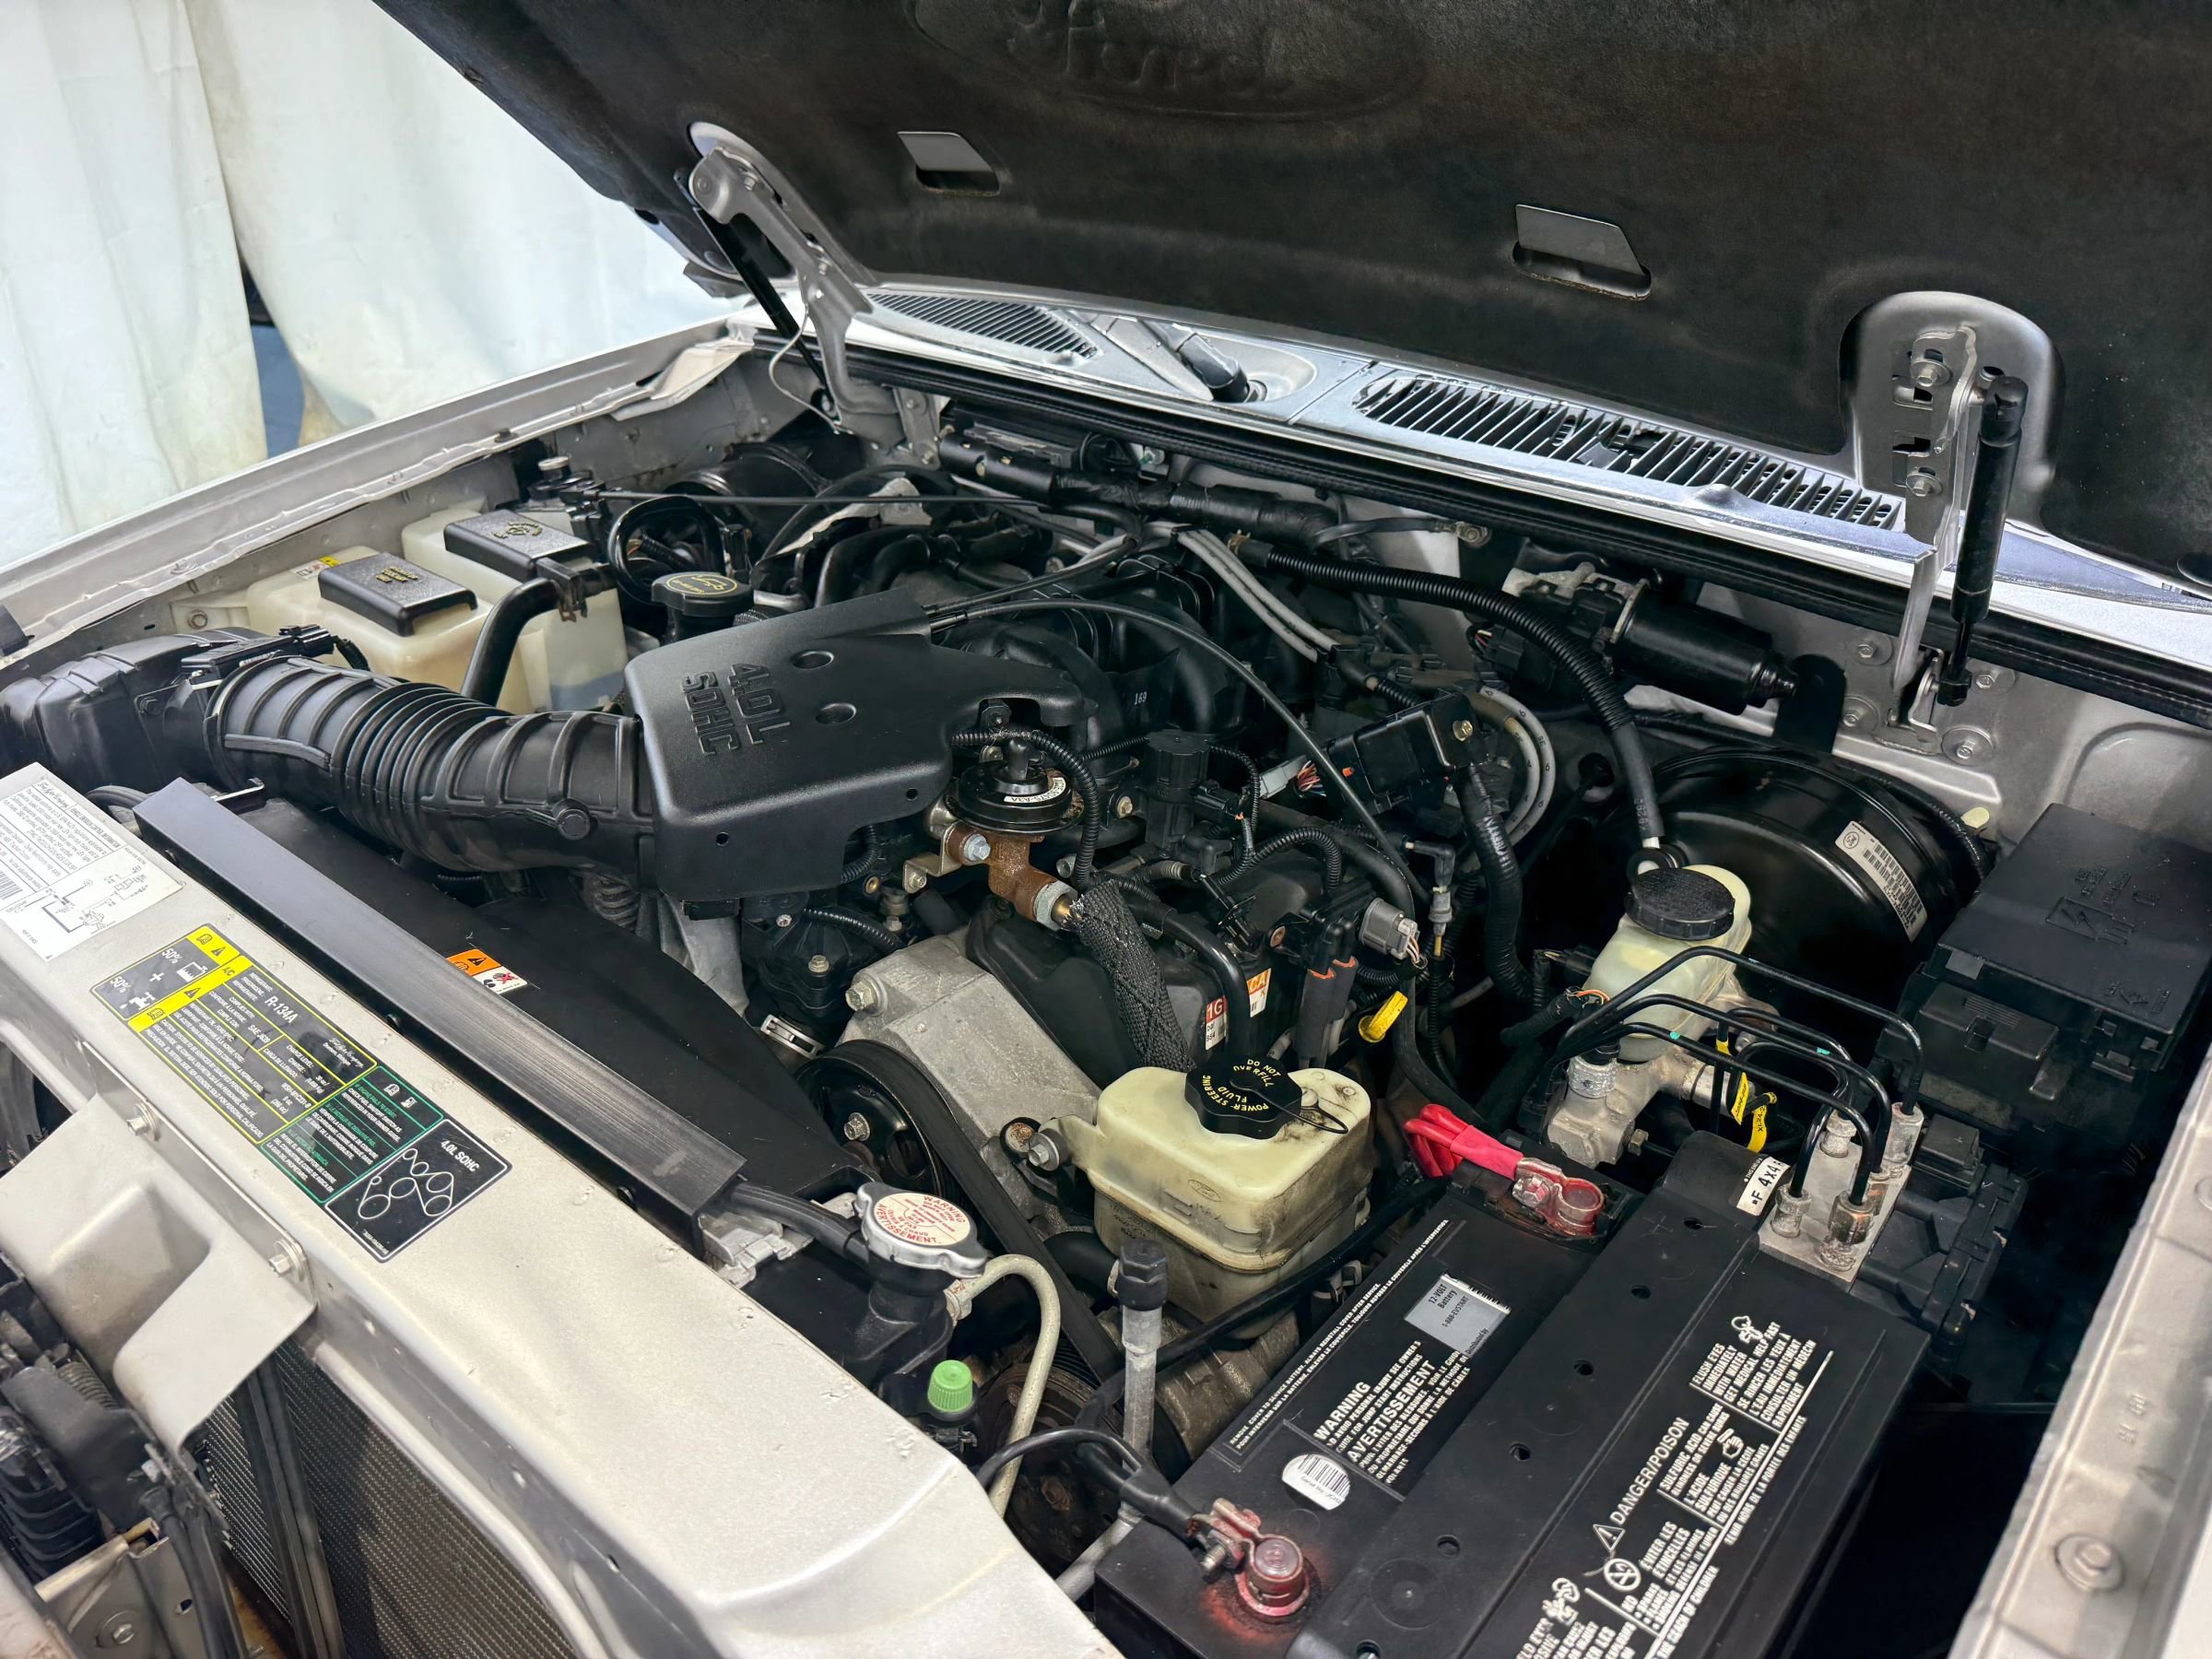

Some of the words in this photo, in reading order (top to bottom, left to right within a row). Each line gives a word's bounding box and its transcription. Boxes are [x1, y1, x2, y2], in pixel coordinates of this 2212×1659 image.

[681, 672, 742, 755] SOHC
[728, 664, 790, 745] 4.0L
[159, 947, 183, 964] 50%
[221, 966, 235, 976] A/C
[108, 974, 133, 993] 50%
[263, 994, 300, 1023] R-134A
[247, 1024, 261, 1035] SAE
[1202, 1075, 1229, 1106] STEERING
[1263, 1065, 1281, 1077] NOT
[1218, 1086, 1247, 1103] FLUID
[1233, 1102, 1269, 1112] POWER
[438, 1138, 459, 1155] 4.0L
[453, 1150, 480, 1172] SOHC
[924, 1195, 966, 1223] WARNING
[1428, 1283, 1447, 1304] 12-VOLT
[1437, 1288, 1458, 1309] Battery
[1235, 1434, 1250, 1449] POUR
[1279, 1393, 1288, 1401] LA
[1350, 1301, 1371, 1324] TOUJOURS
[1389, 1258, 1412, 1280] COUVERCLE
[1464, 1332, 1484, 1354] Distributed
[1479, 1326, 1488, 1335] by
[1247, 1407, 1265, 1424] COVER
[1338, 1312, 1354, 1326] COVER
[1350, 1299, 1365, 1312] AFTER
[1692, 1360, 1713, 1384] FLUSH
[1706, 1342, 1725, 1362] EYES
[1702, 1344, 1737, 1391] IMMEDIATELY
[1712, 1374, 1732, 1396] WITH
[1724, 1350, 1747, 1378] WATER
[1723, 1384, 1739, 1403] GET
[1732, 1355, 1759, 1388] MEDICAL
[1751, 1337, 1770, 1358] HELP
[1763, 1320, 1781, 1340] FAST
[1735, 1395, 1750, 1409] SE
[1743, 1370, 1767, 1399] RINCER
[1759, 1356, 1775, 1372] LES
[1768, 1337, 1787, 1359] YEUX
[1312, 1380, 1371, 1441] WARNING
[1333, 1418, 1353, 1439] AVOID
[1348, 1392, 1376, 1421] PERSONAL
[1371, 1372, 1394, 1394] INJURY
[1388, 1362, 1402, 1374] SEE
[1350, 1421, 1364, 1435] FOR
[1359, 1406, 1378, 1423] JUMP
[1373, 1389, 1393, 1407] START
[1388, 1353, 1423, 1391] INSTRUCTIONS
[1388, 1418, 1403, 1432] DES
[1427, 1371, 1441, 1386] VOIR
[1437, 1365, 1447, 1373] LE
[1407, 1412, 1420, 1425] QUI
[1416, 1394, 1435, 1414] DONNE
[1431, 1385, 1442, 1395] LA
[1443, 1385, 1454, 1395] DE
[1747, 1392, 1769, 1417] L'EAU
[1759, 1379, 1792, 1422] CONSULTER
[1783, 1368, 1798, 1382] UN
[1771, 1381, 1805, 1429] RAPIDEMENT
[1345, 1359, 1437, 1463] AVERTISSEMENT
[1658, 1451, 1691, 1492] SULFURIC
[1683, 1431, 1703, 1454] ACID
[1696, 1419, 1712, 1435] CAN
[1704, 1402, 1724, 1422] CAUSE
[1690, 1452, 1704, 1465] OR
[1608, 1415, 1689, 1526] DANGER/POISON
[1682, 1471, 1710, 1506] L'ACIDE
[1693, 1461, 1732, 1512] SULFURIQUE
[1736, 1500, 1756, 1524] HORS
[1747, 1491, 1761, 1504] DE
[1754, 1479, 1768, 1494] LA
[1775, 1441, 1791, 1458] DES
[1657, 1519, 1677, 1542] LES
[1619, 1593, 1640, 1614] NO
[1688, 1563, 1719, 1606] CHILDREN
